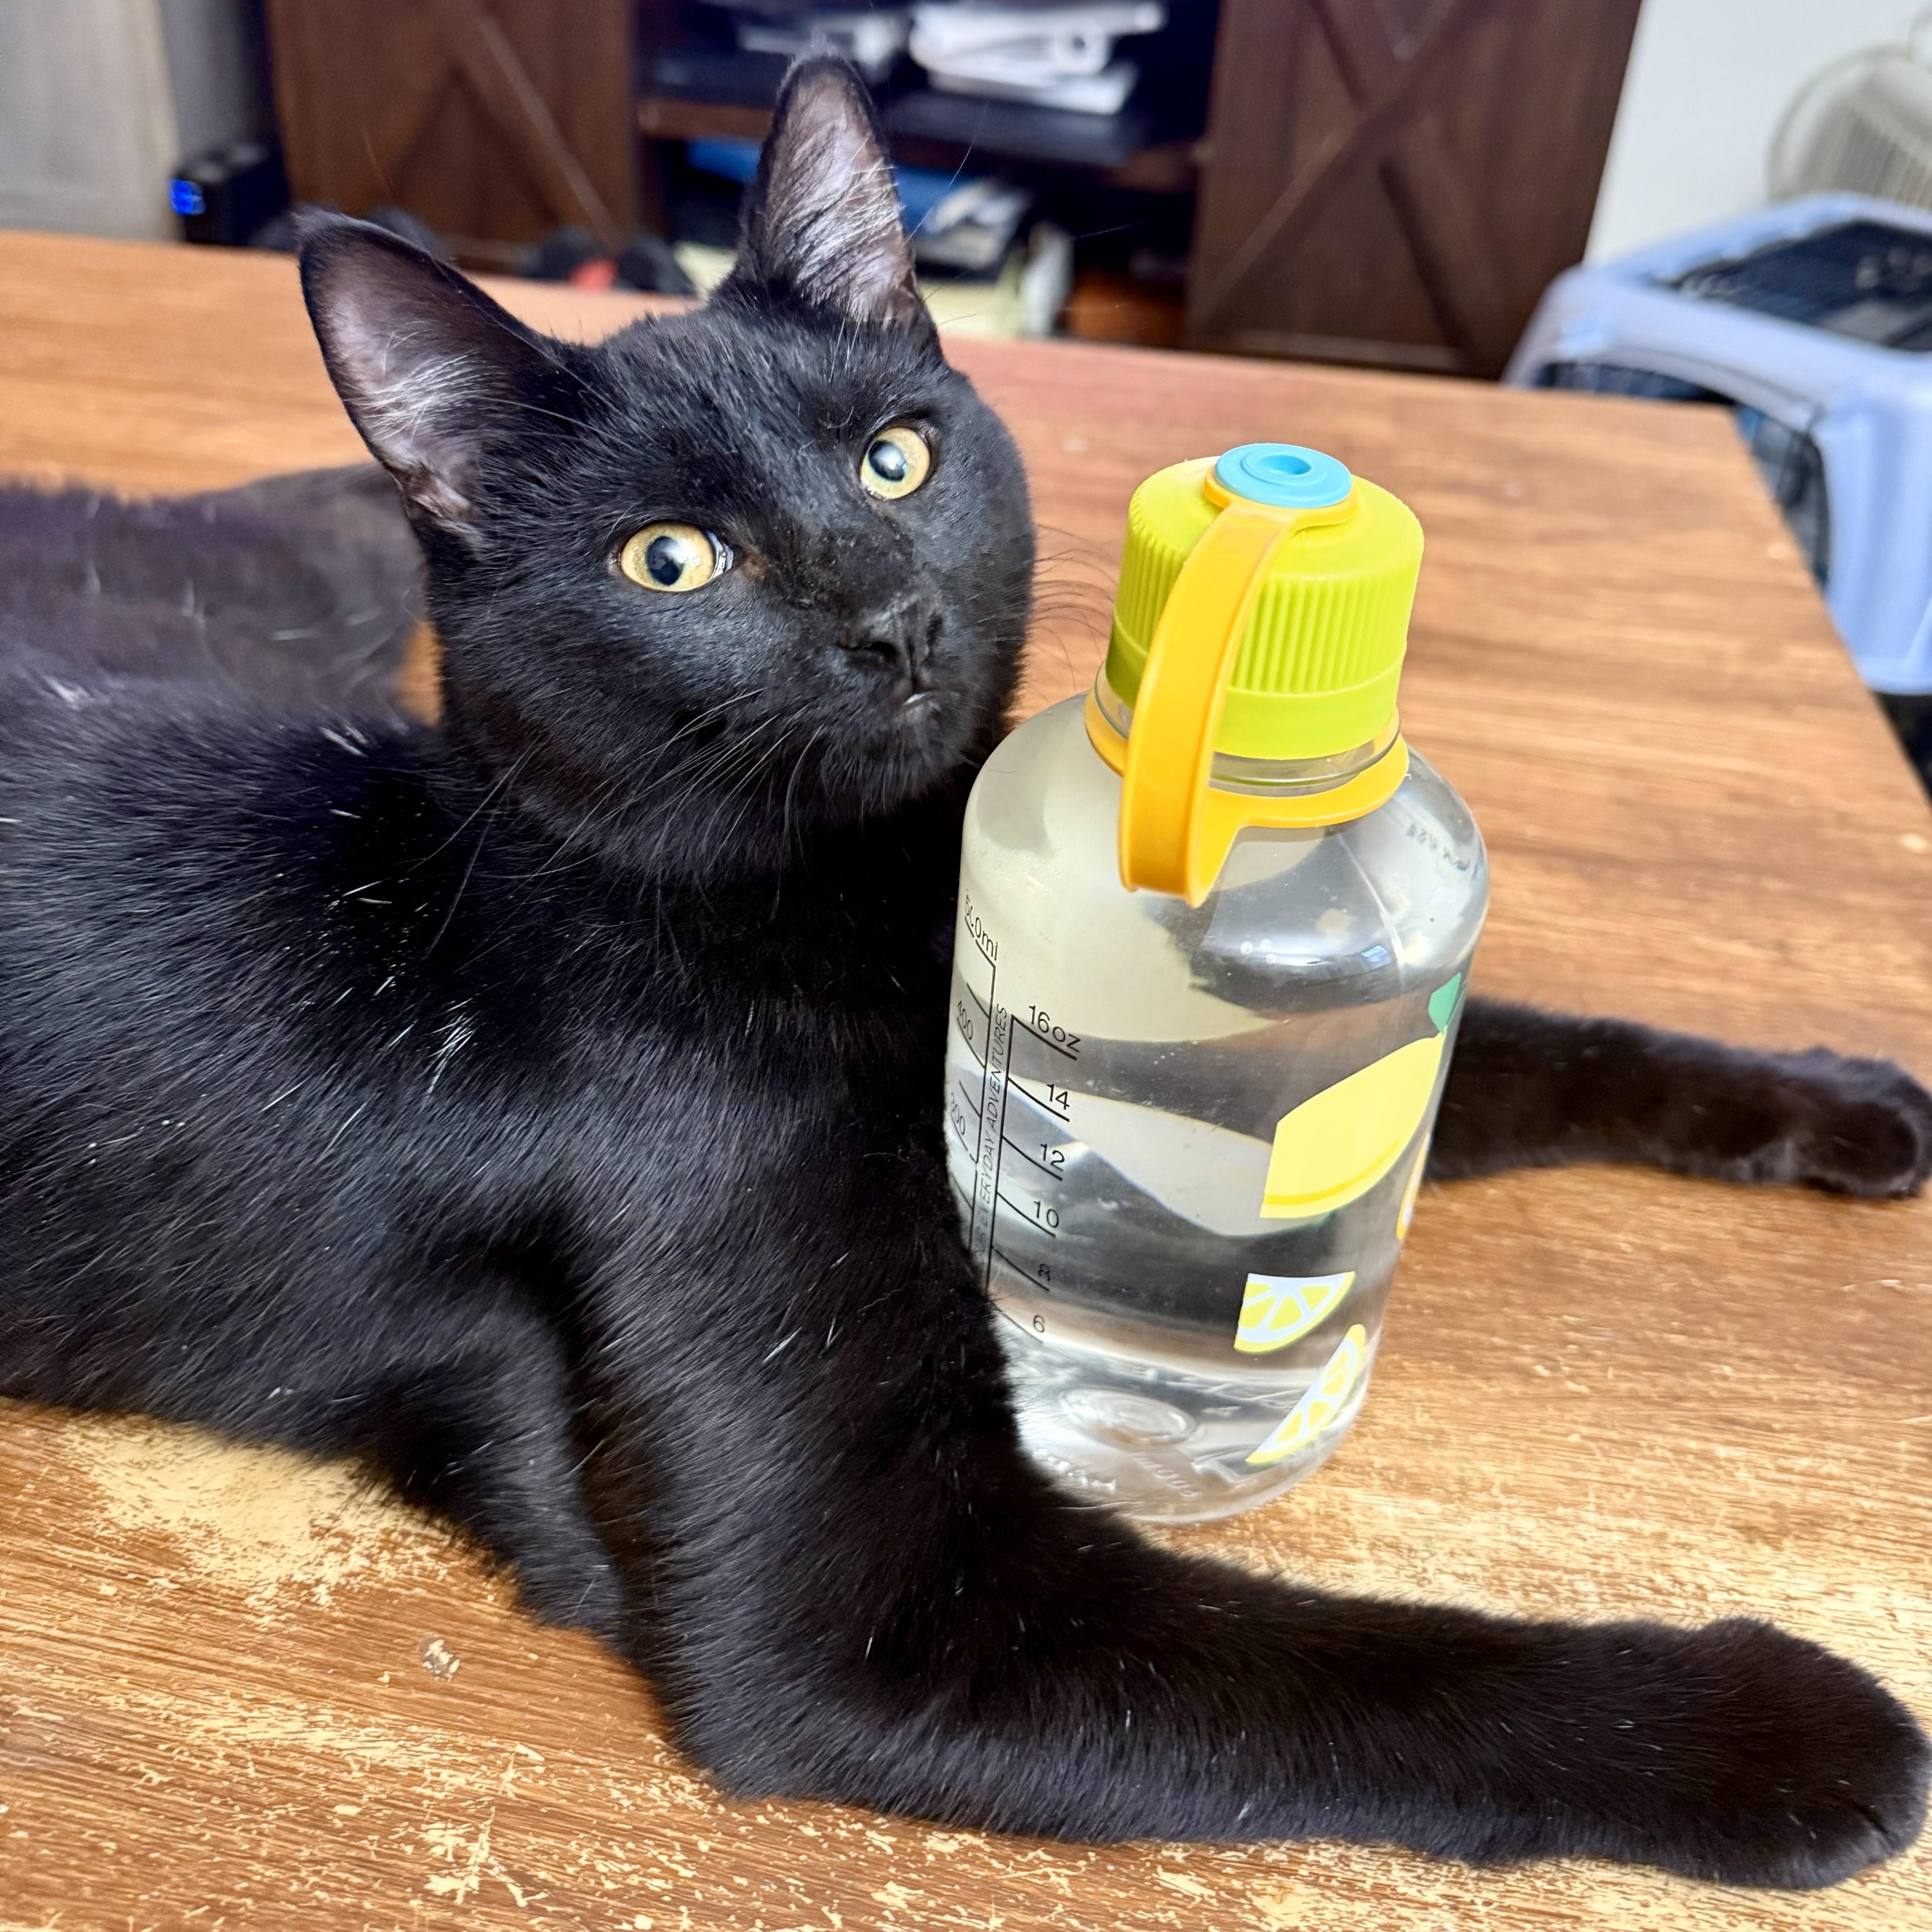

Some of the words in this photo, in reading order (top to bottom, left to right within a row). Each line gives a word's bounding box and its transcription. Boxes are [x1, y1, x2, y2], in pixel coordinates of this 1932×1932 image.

[1029, 1005, 1081, 1053] 16oz
[986, 1003, 1007, 1136] ADVENTURES
[1046, 1083, 1070, 1110] 14
[1040, 1143, 1065, 1171] 12
[1034, 1200, 1059, 1228] 10
[1033, 1314, 1045, 1333] 6
